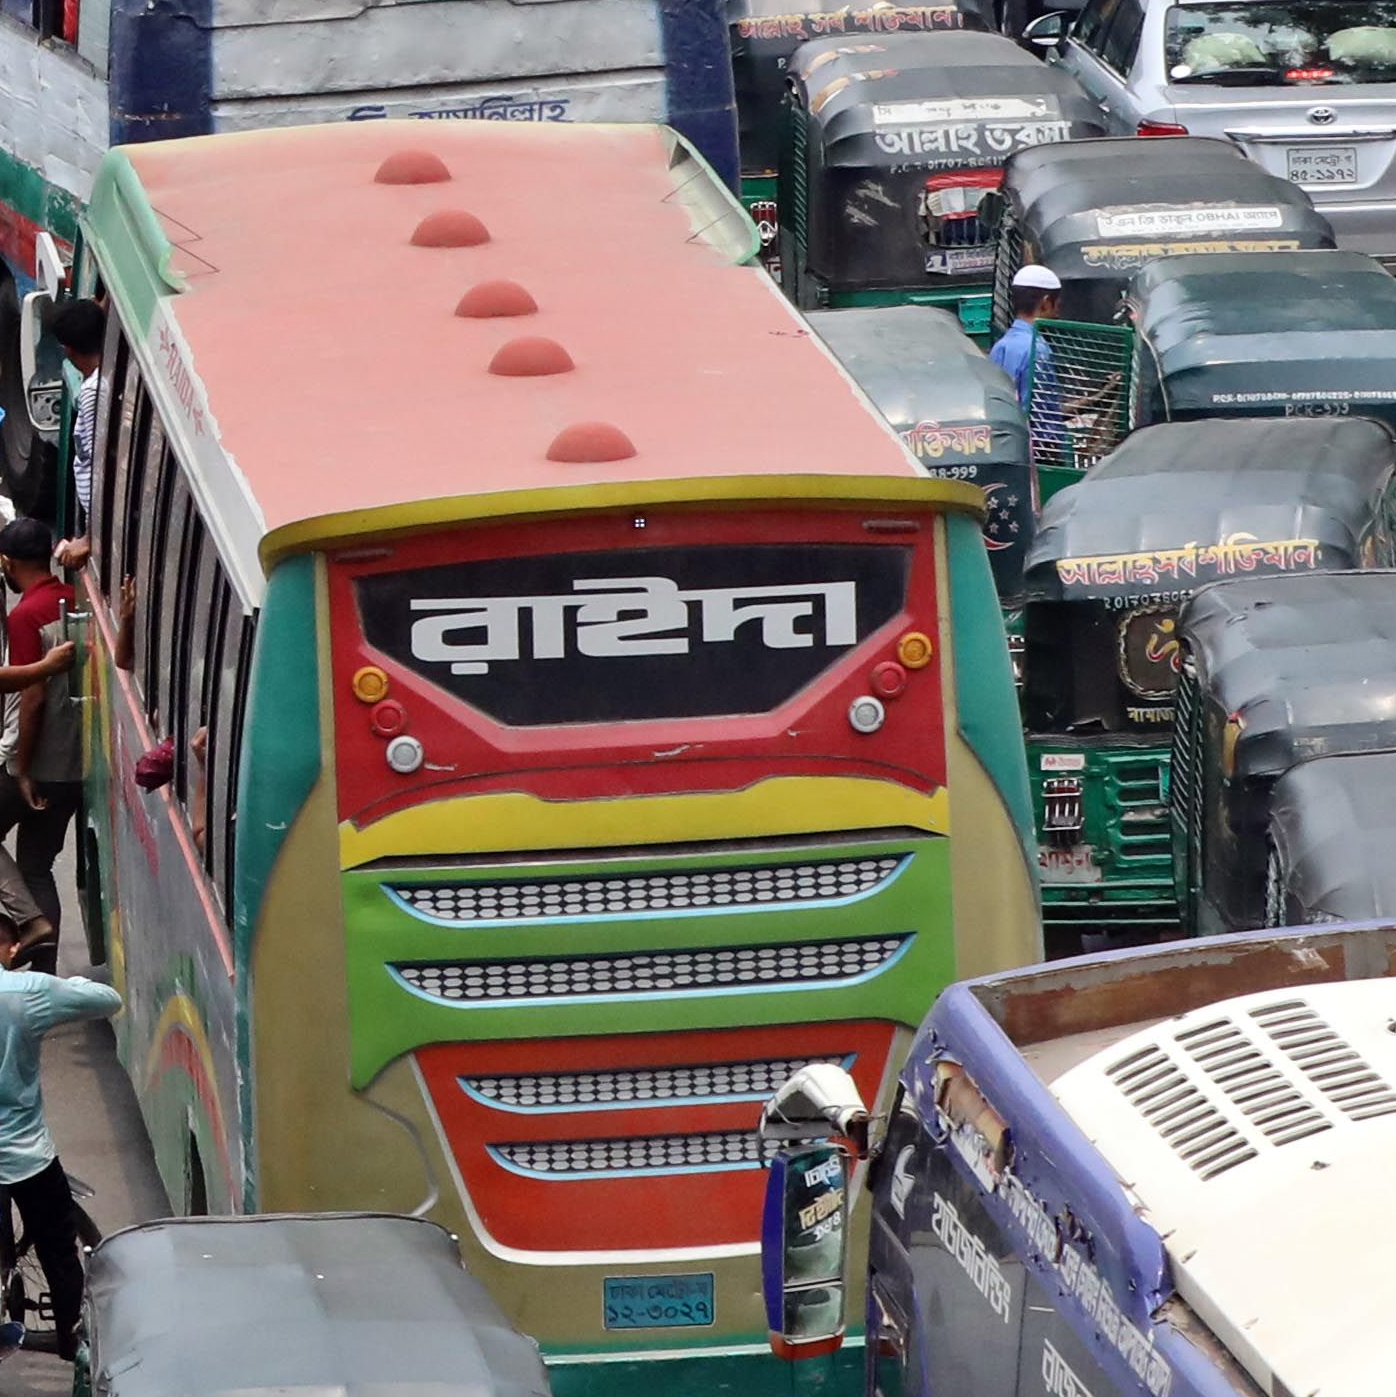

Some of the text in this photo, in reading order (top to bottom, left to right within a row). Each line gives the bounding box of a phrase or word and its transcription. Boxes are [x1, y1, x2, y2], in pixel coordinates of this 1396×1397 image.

[736, 12, 807, 40] আল্লাহ
[811, 4, 850, 34] সর্ব
[874, 120, 1073, 155] আল্লাহ ভরসা
[1196, 211, 1241, 223] OBHAI
[410, 577, 858, 675] রাইদা
